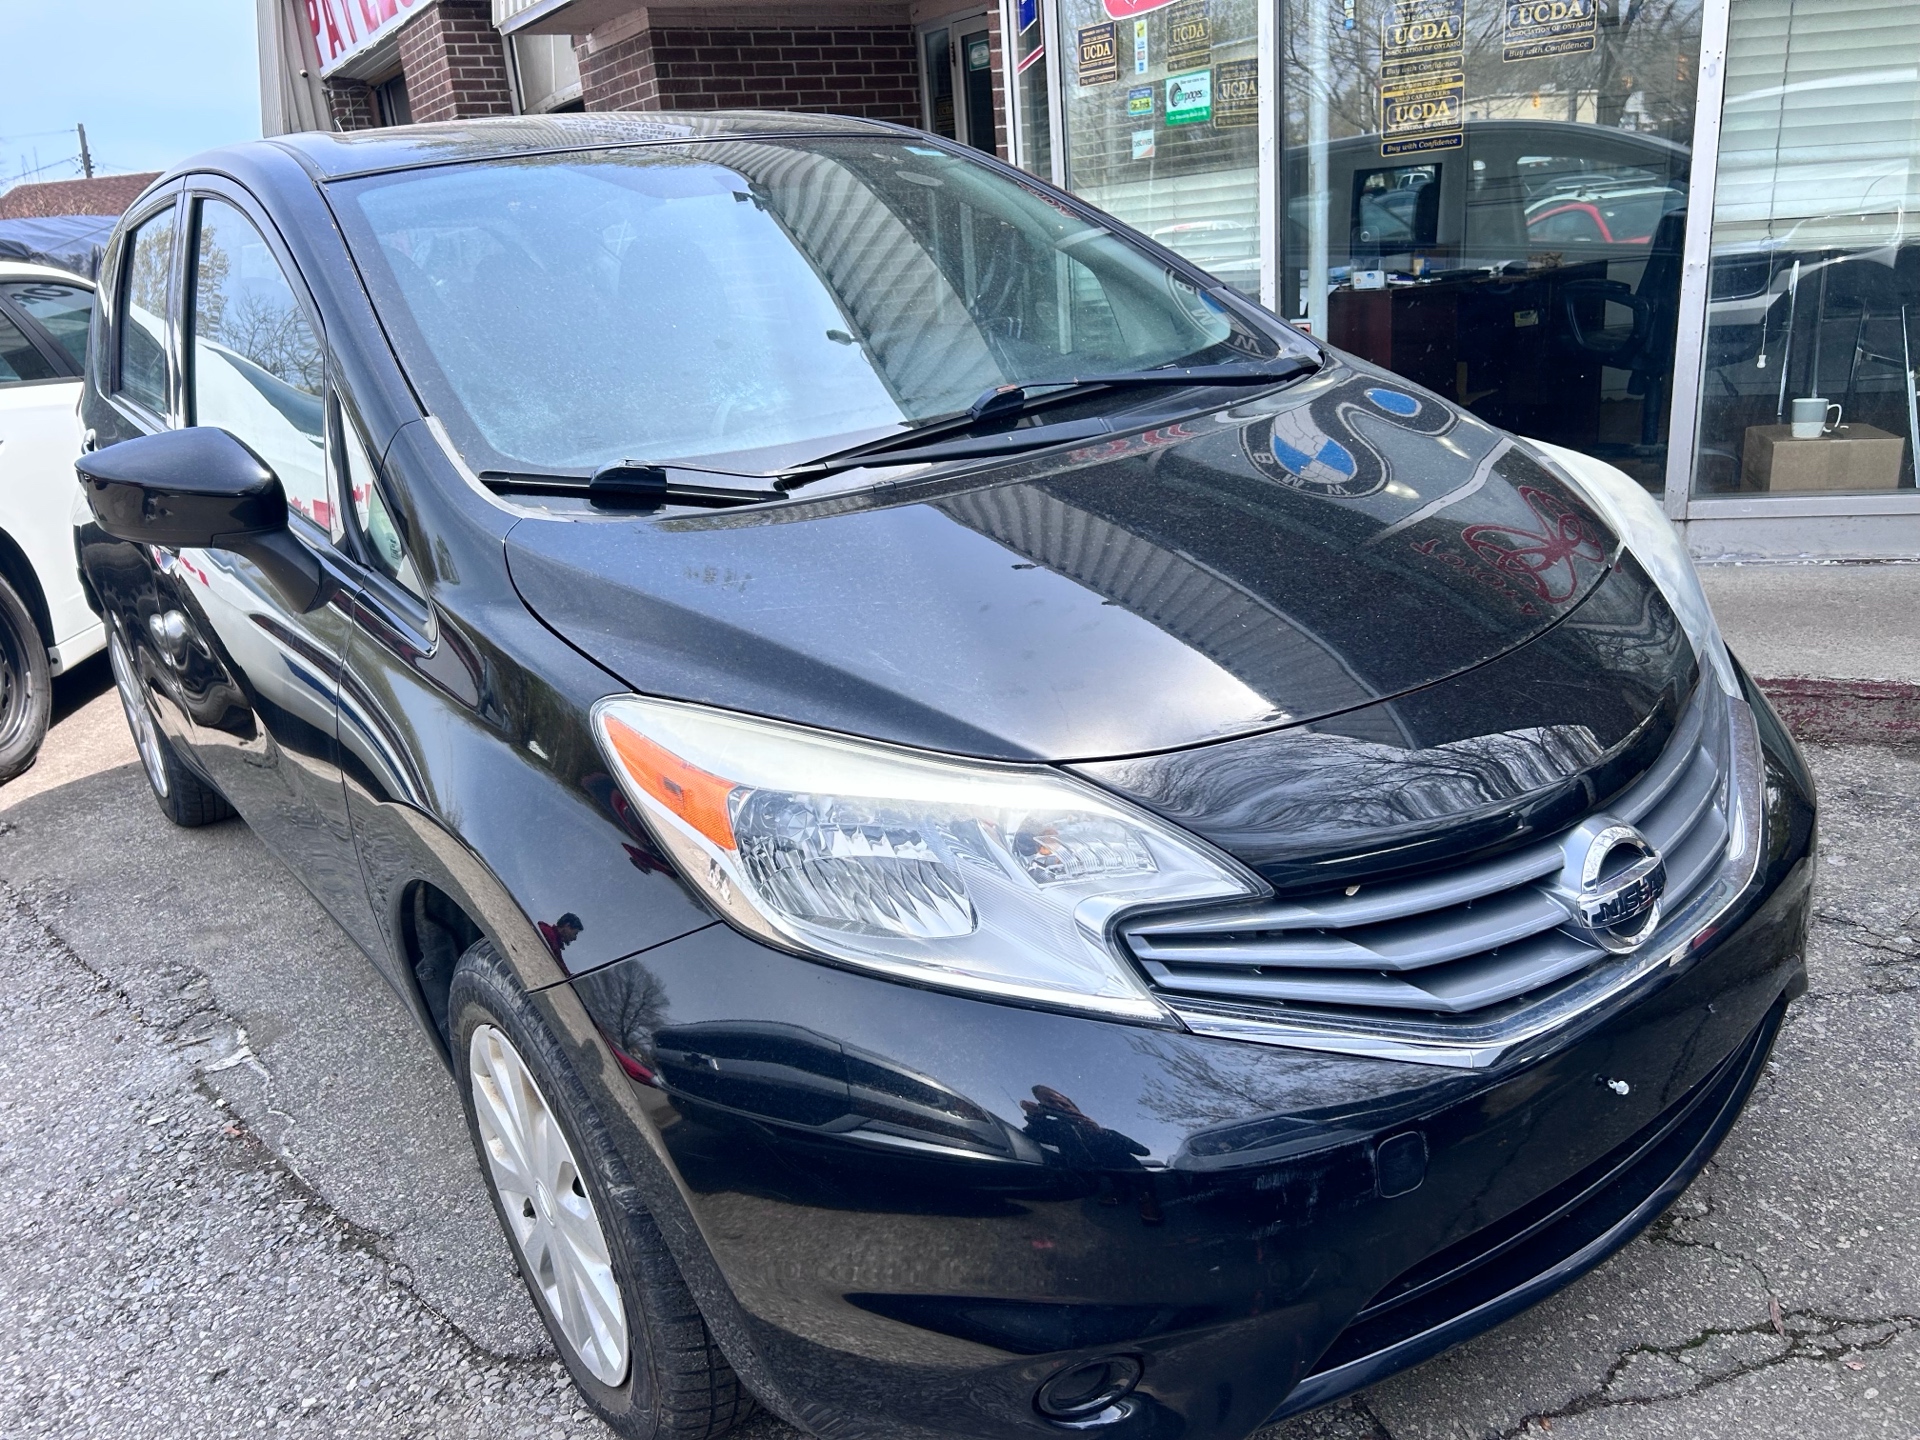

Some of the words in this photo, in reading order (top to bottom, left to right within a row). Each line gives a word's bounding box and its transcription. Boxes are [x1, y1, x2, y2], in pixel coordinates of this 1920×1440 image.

[1518, 0, 1584, 25] UCDA
[1173, 22, 1206, 43] UCDA
[1394, 21, 1454, 45] UCDA
[1506, 27, 1550, 38] ASSOCIATION
[1551, 24, 1561, 32] OF
[1562, 20, 1593, 30] ONTARIO
[1083, 42, 1112, 60] UCDA
[1433, 41, 1461, 50] ONTARIO
[1526, 46, 1543, 54] with
[1544, 41, 1590, 53] Confidence
[1401, 65, 1417, 73] with
[1418, 60, 1458, 71] Confidence
[1222, 80, 1258, 100] UCDA
[1394, 100, 1451, 122] UCDA
[1402, 142, 1418, 151] with
[1418, 138, 1458, 148] Confidence
[1598, 868, 1667, 922] NISSAN
